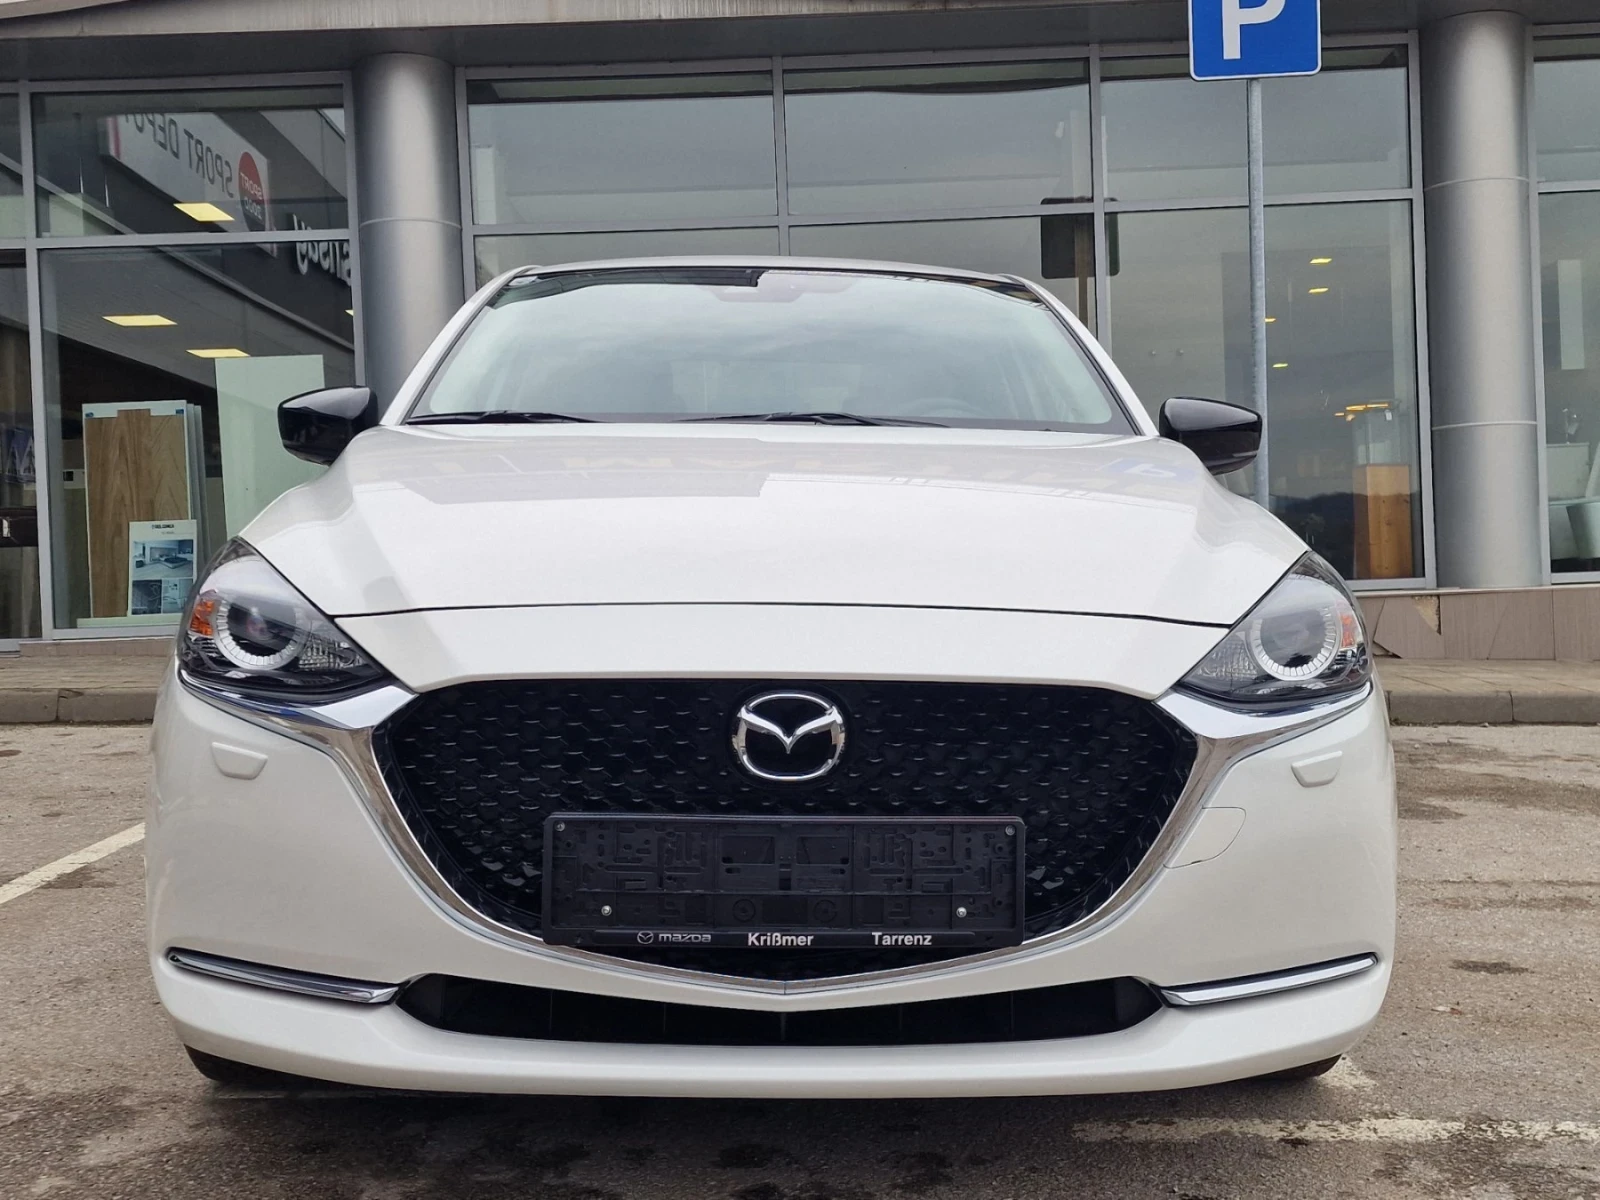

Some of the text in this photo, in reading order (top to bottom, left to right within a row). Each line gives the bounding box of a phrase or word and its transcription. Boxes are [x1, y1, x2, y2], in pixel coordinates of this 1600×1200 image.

[1221, 0, 1286, 60] P
[658, 931, 932, 946] mazda Krißmer Tarrenz
